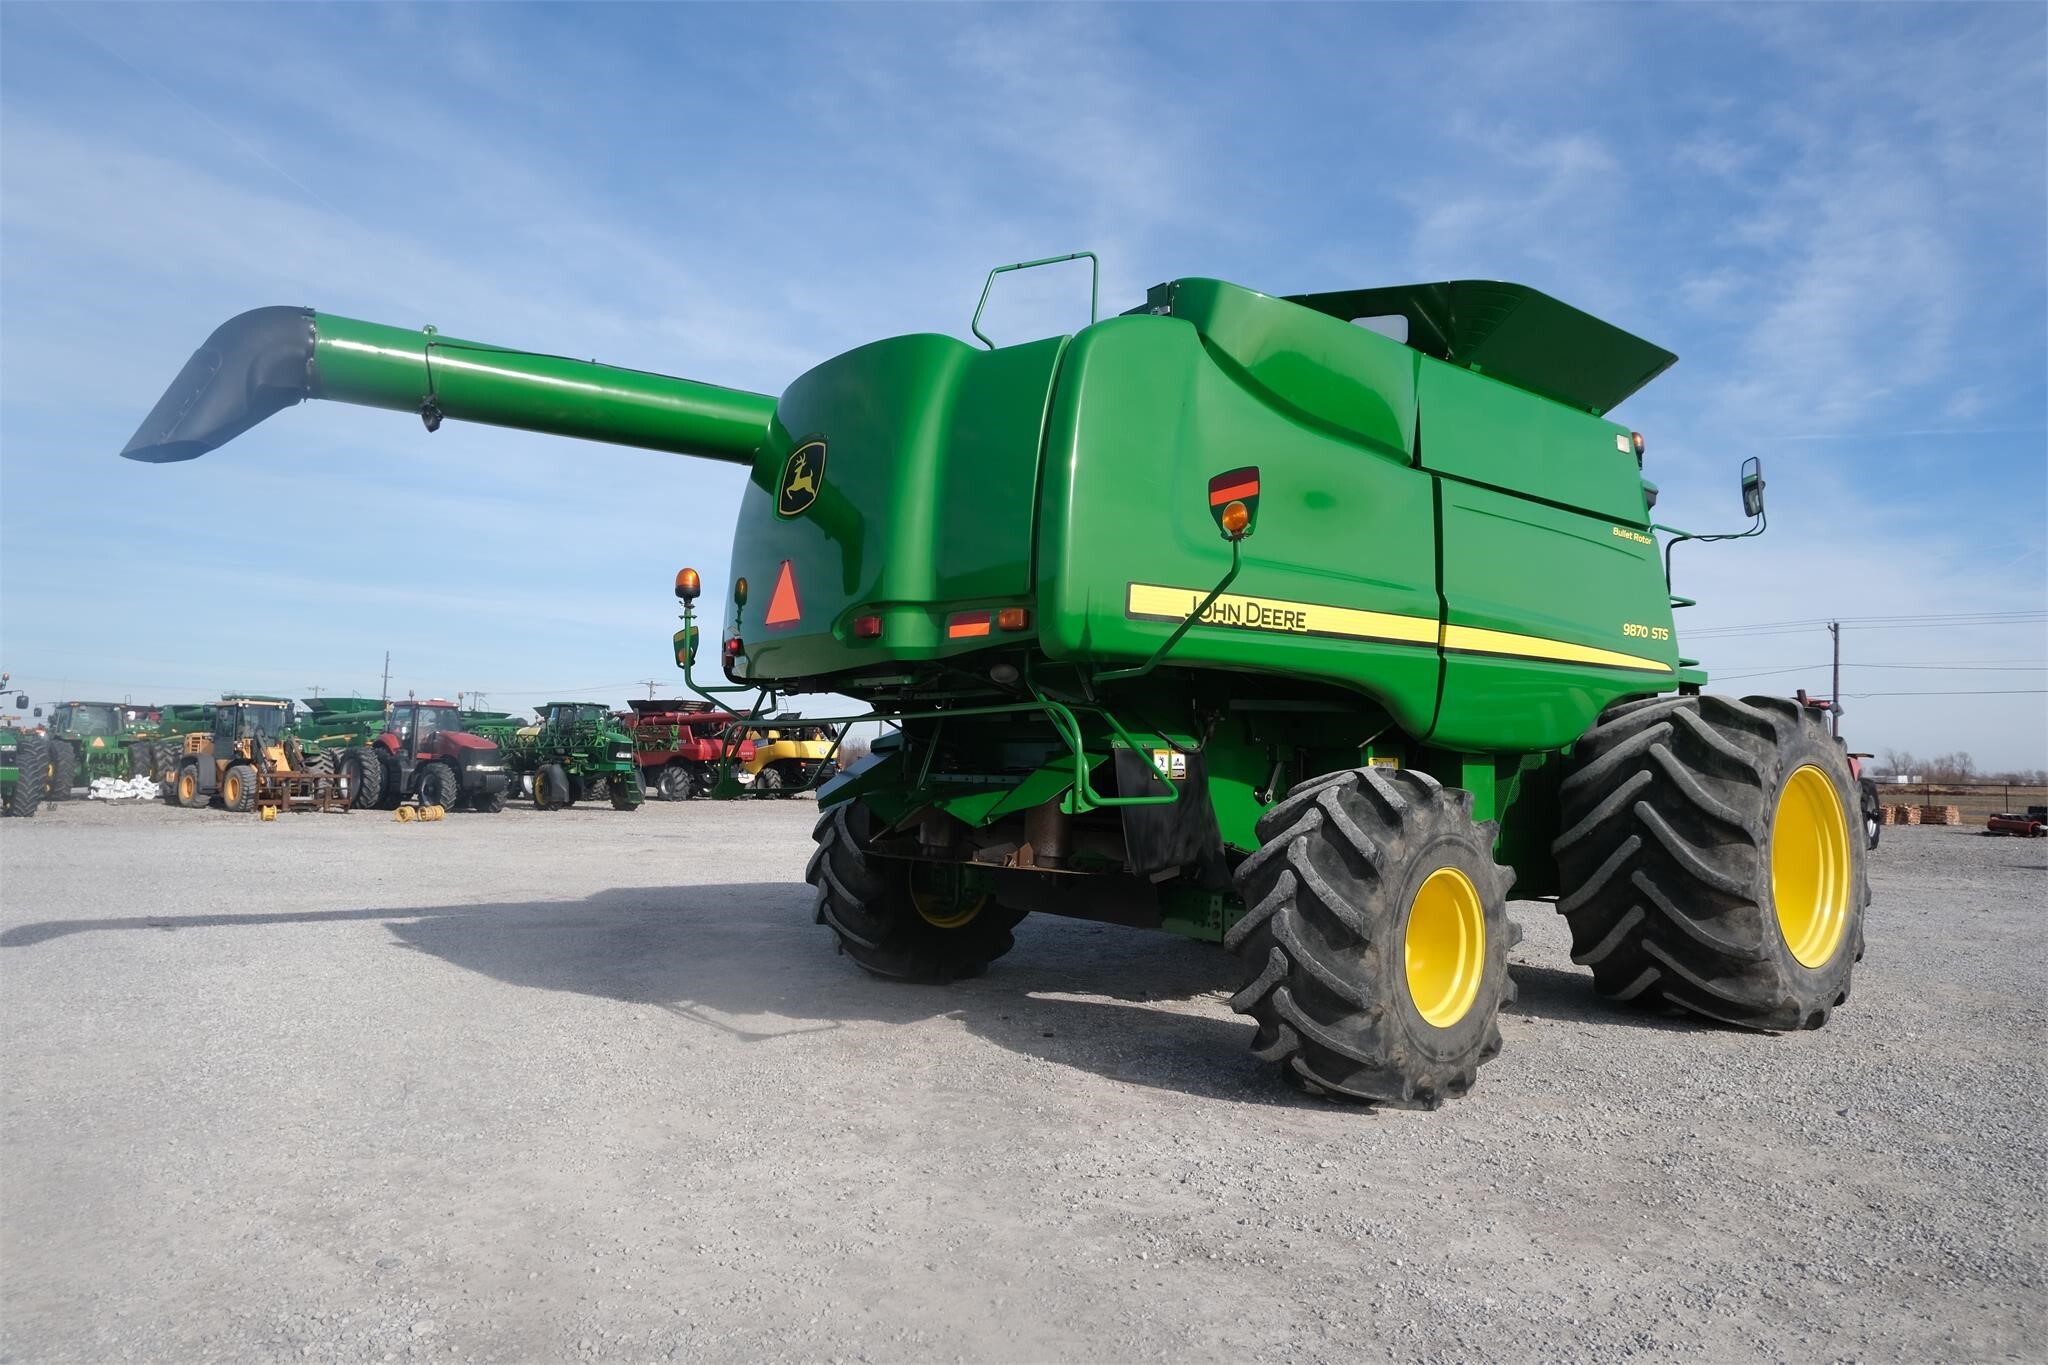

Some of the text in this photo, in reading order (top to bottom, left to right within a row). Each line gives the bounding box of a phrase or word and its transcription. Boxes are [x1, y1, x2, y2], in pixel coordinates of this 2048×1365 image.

[1612, 527, 1652, 545] Bullet Rotor
[1246, 602, 1307, 629] DEERE
[1623, 623, 1669, 641] 9870 STS
